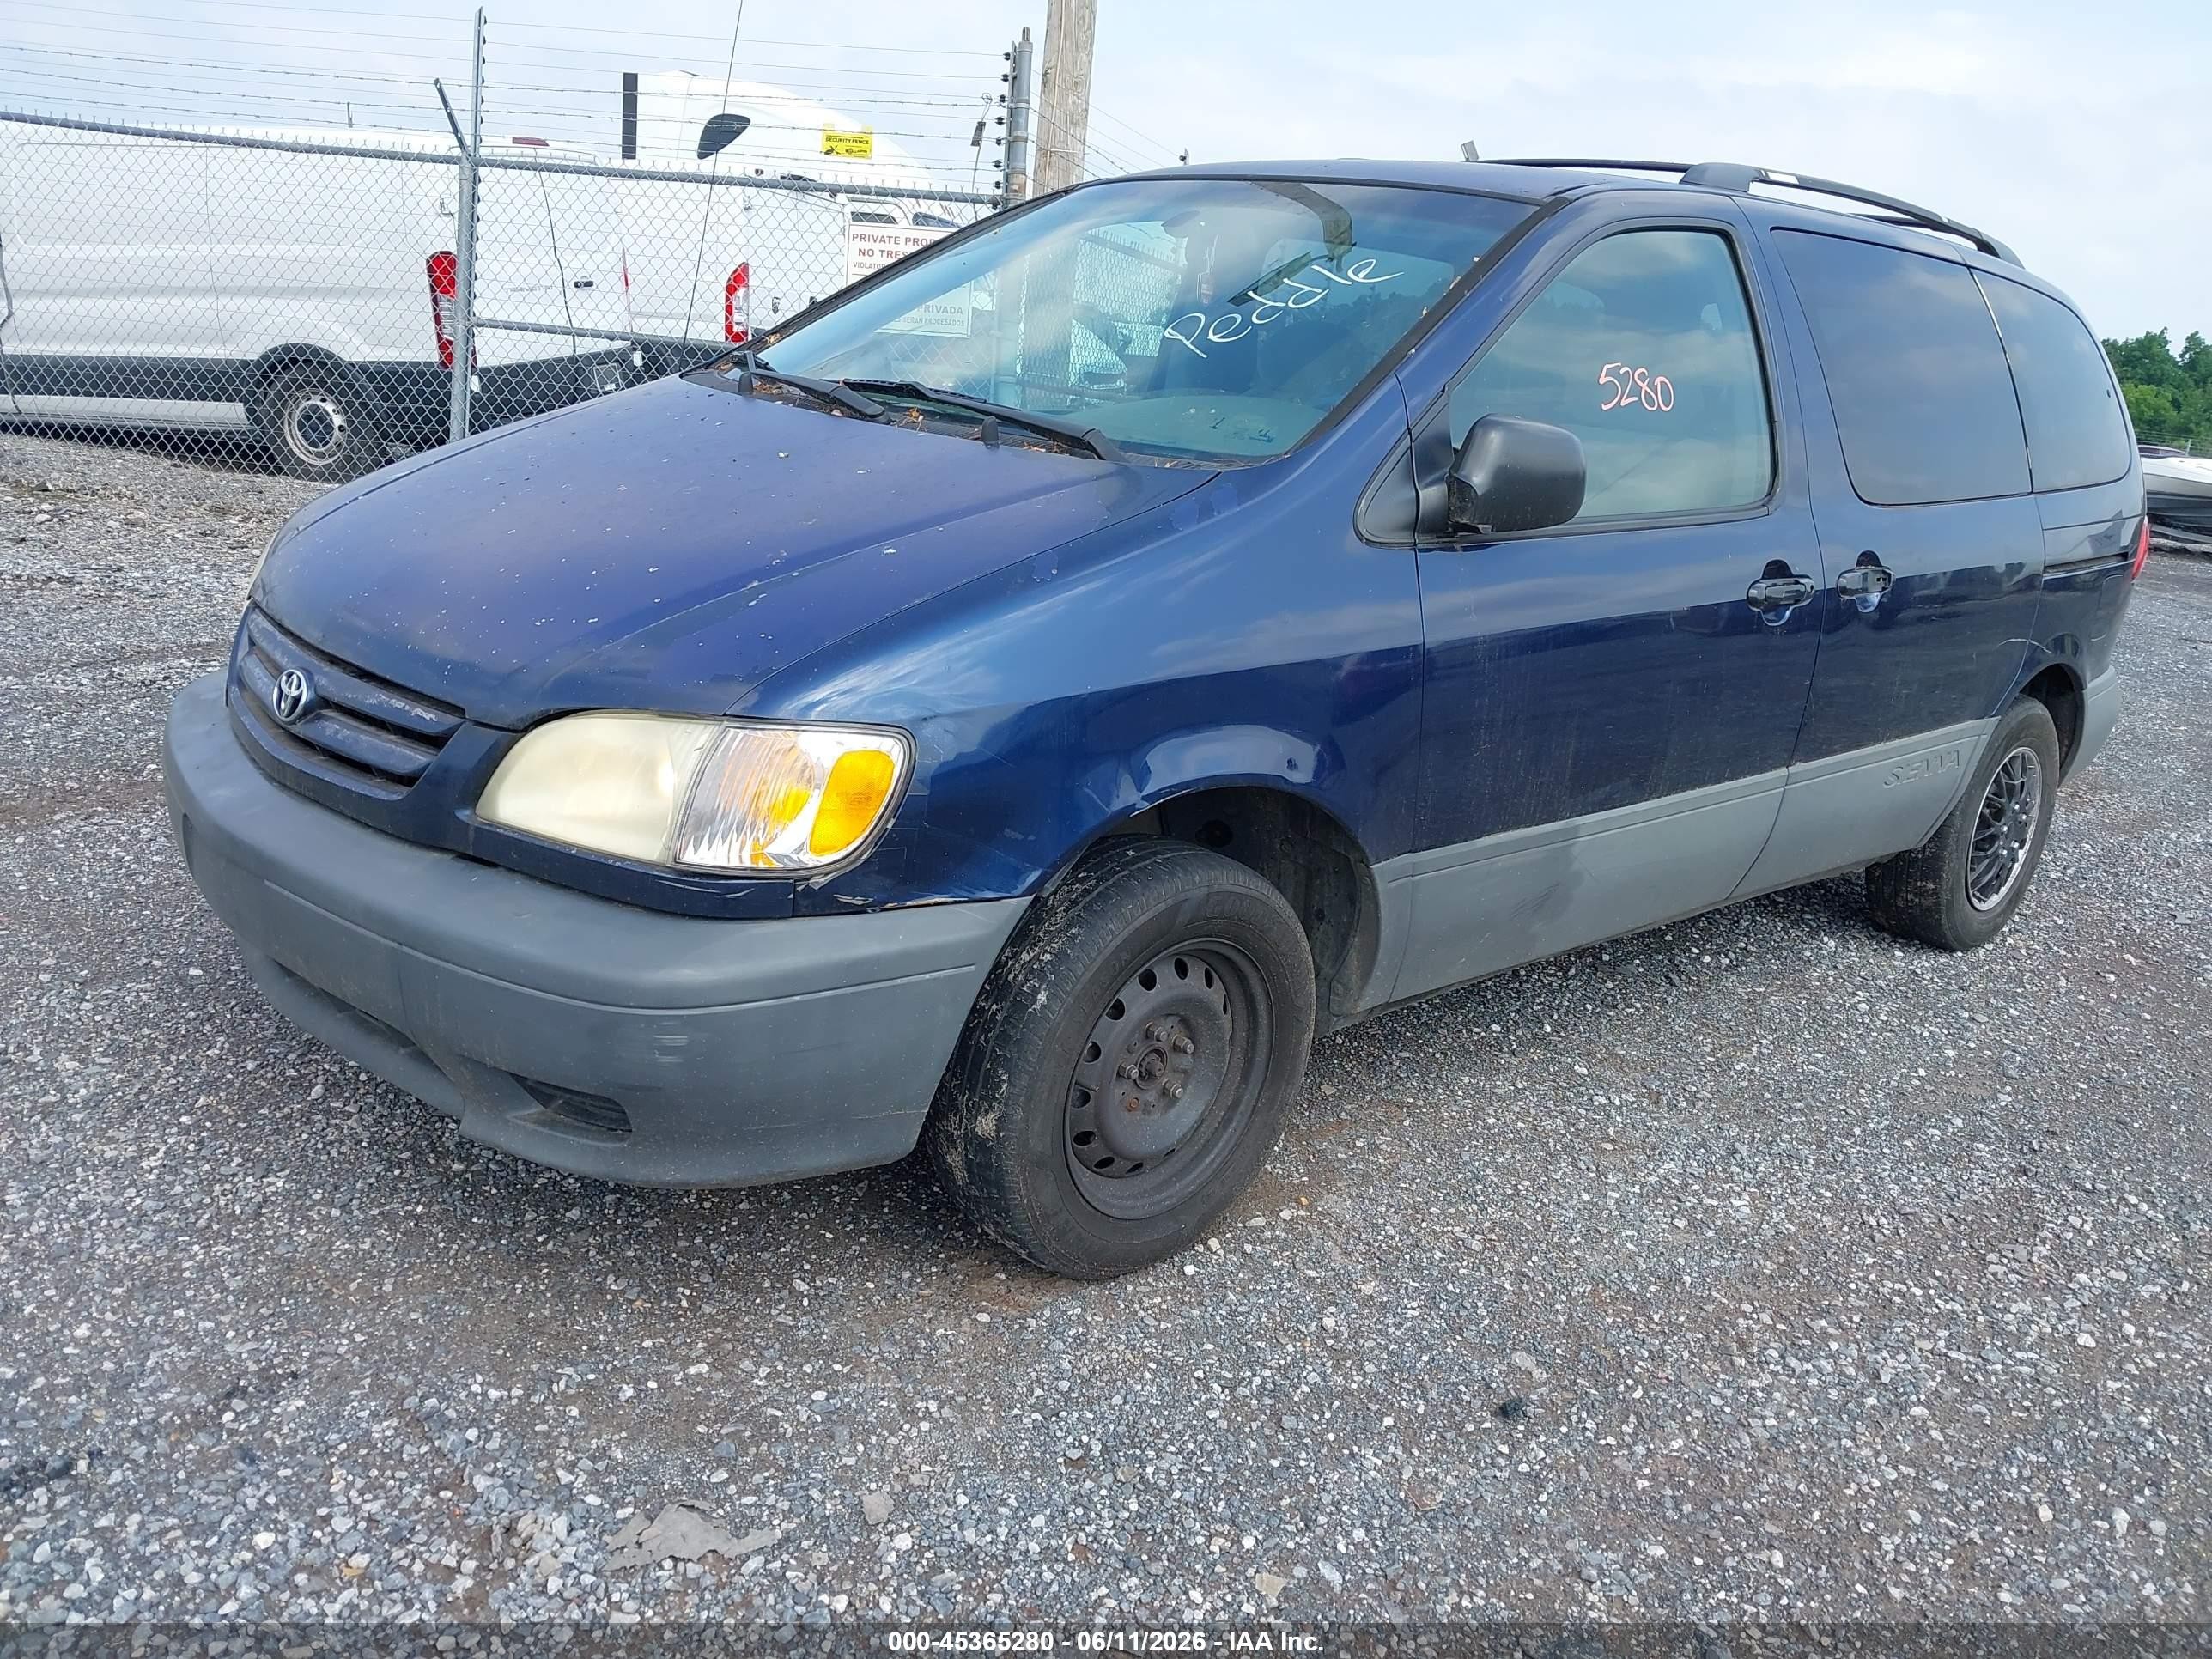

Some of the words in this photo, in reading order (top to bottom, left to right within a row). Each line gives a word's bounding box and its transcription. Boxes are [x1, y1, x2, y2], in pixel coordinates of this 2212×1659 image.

[852, 233, 901, 245] PRIVATE
[859, 247, 874, 258] NO
[1599, 362, 1674, 412] 5280
